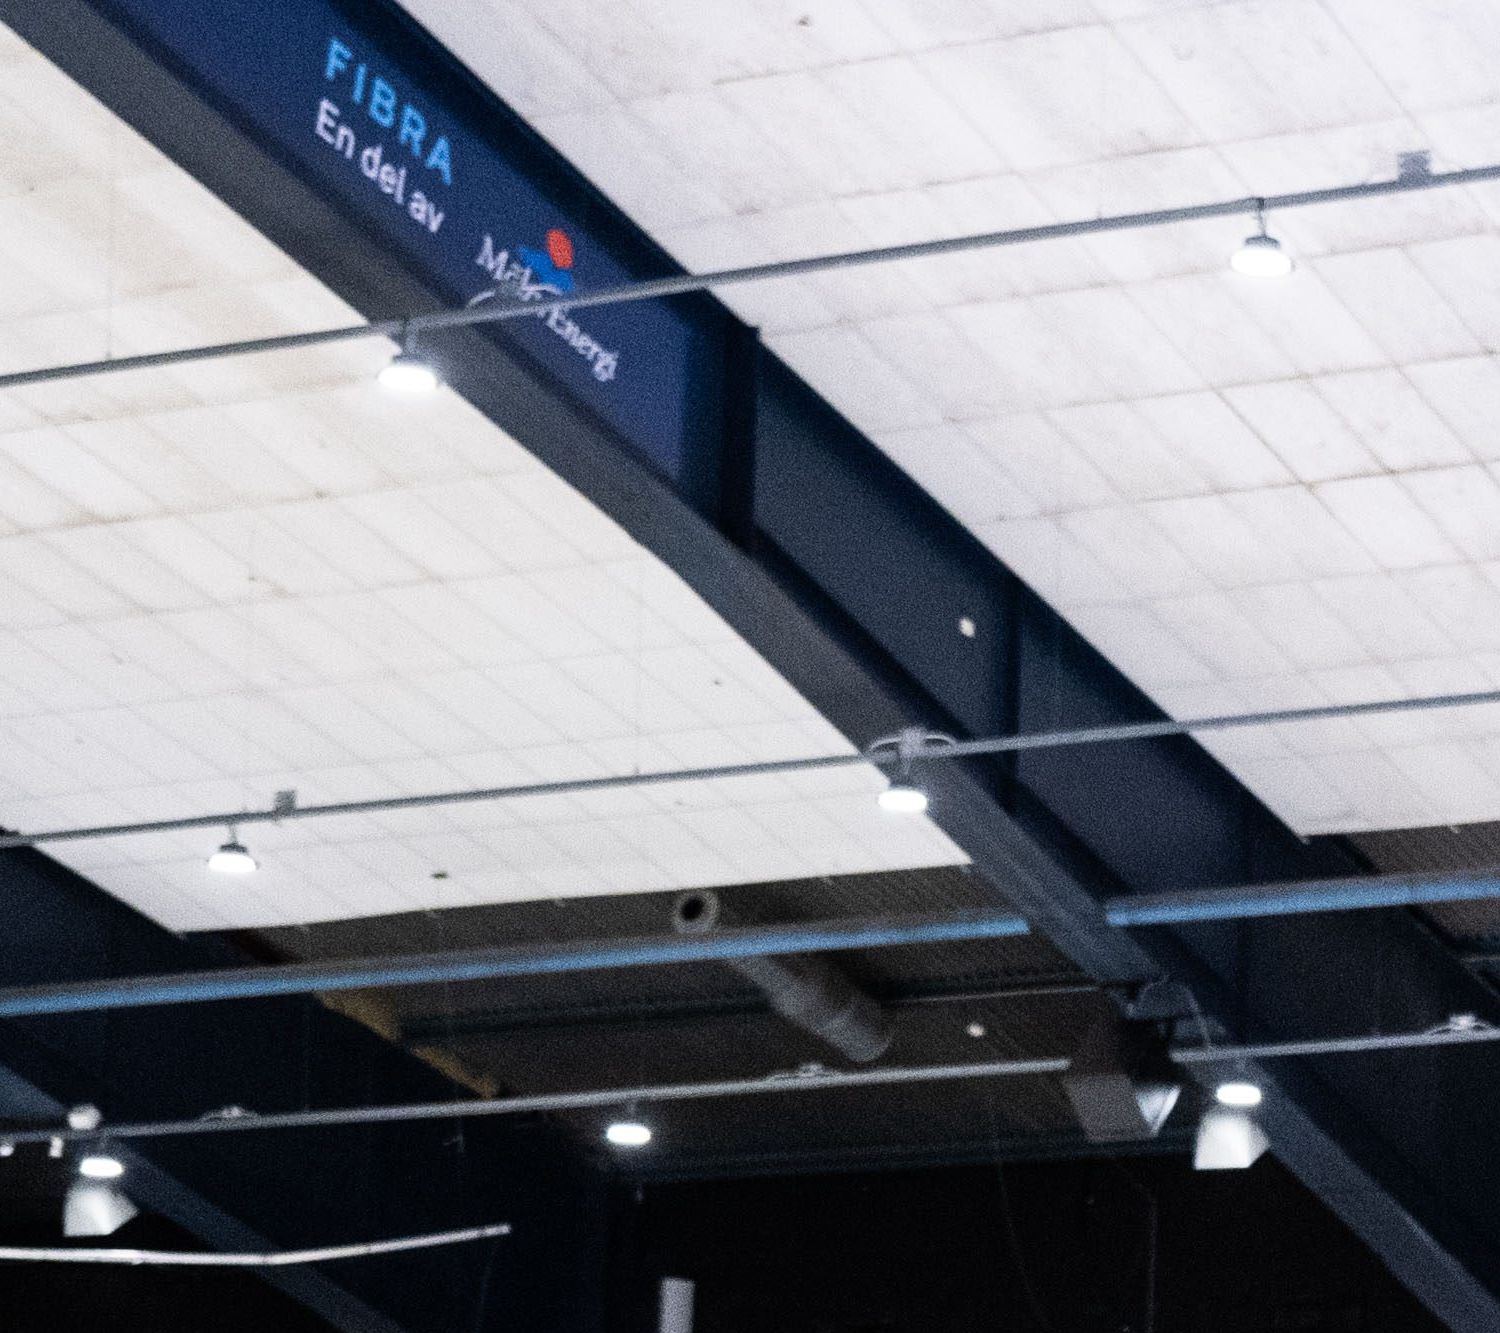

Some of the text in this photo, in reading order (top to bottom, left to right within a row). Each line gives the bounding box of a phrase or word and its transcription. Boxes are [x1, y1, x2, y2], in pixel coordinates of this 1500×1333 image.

[314, 99, 446, 235] En del av
[323, 37, 453, 187] FIBRA
